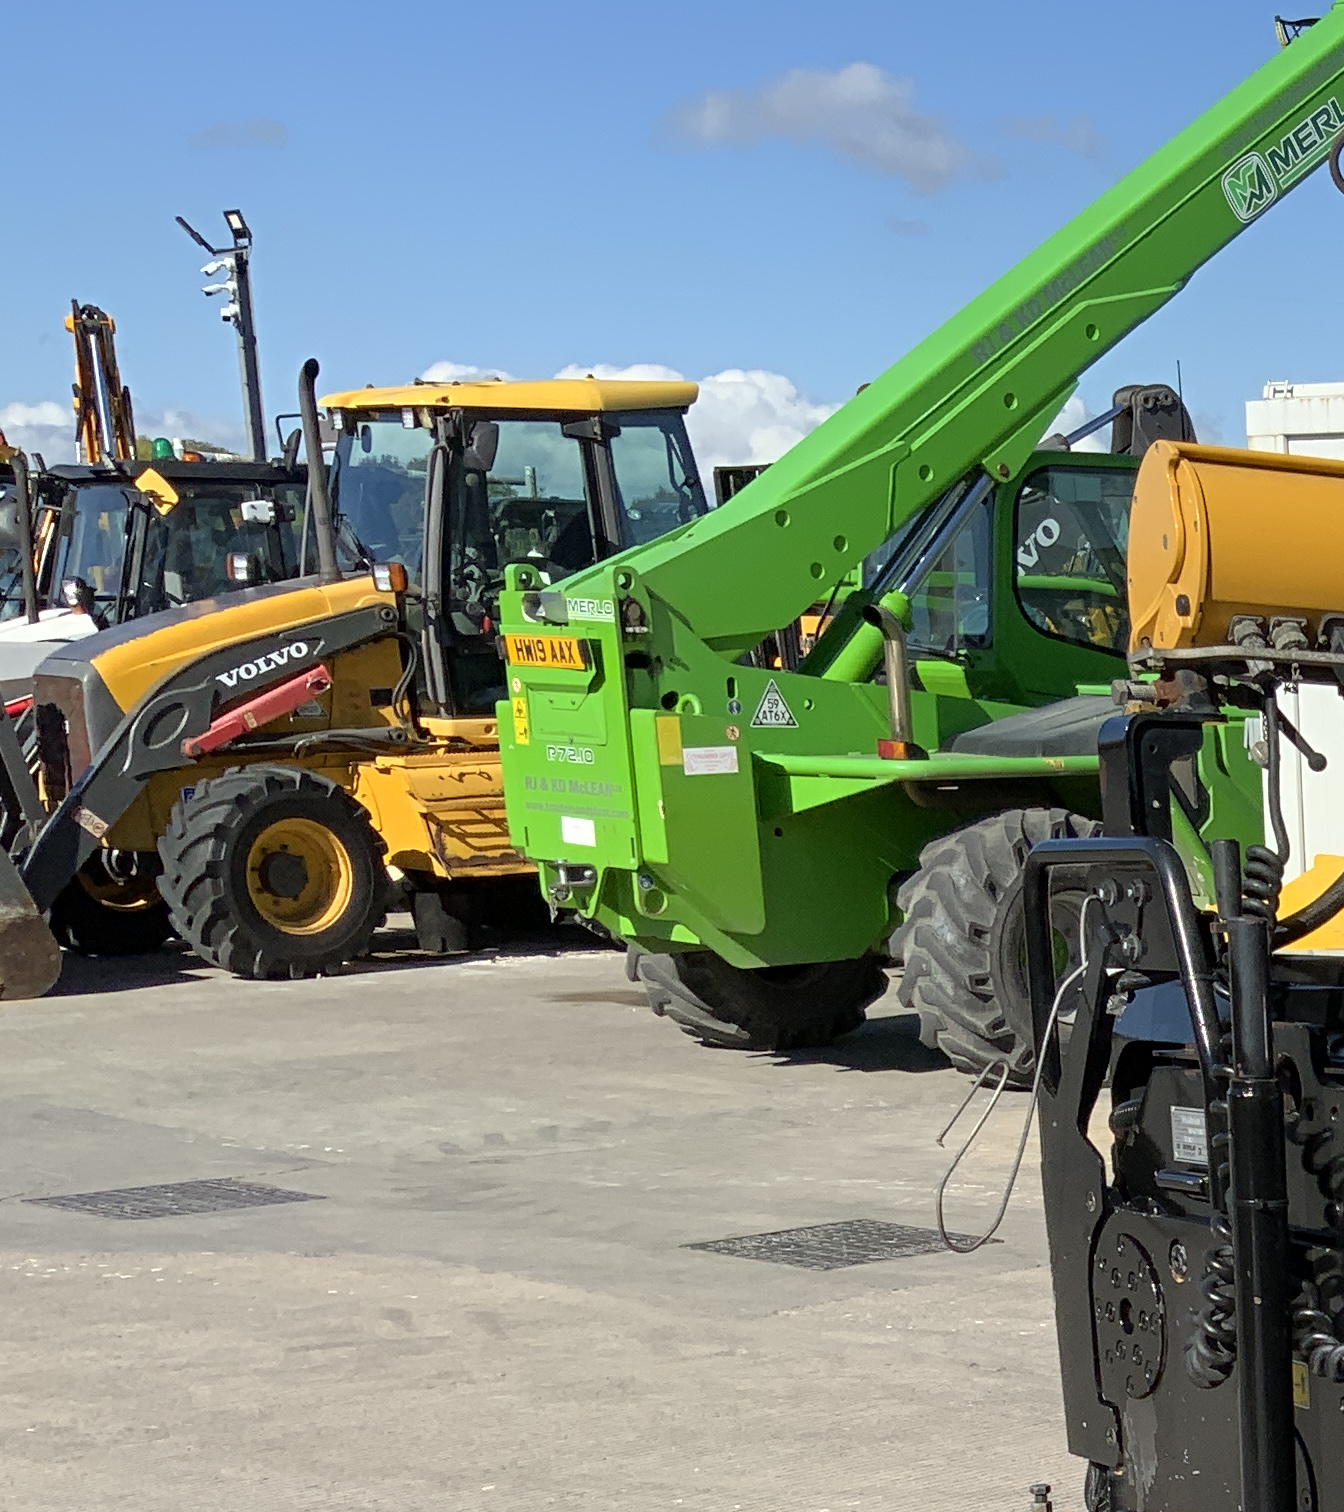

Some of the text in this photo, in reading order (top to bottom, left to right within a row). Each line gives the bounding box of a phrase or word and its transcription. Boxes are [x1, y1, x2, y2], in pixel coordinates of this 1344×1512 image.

[567, 599, 613, 615] MERLO
[513, 638, 577, 665] HW19 AAX
[215, 641, 309, 687] VOLVO
[767, 698, 779, 710] 59
